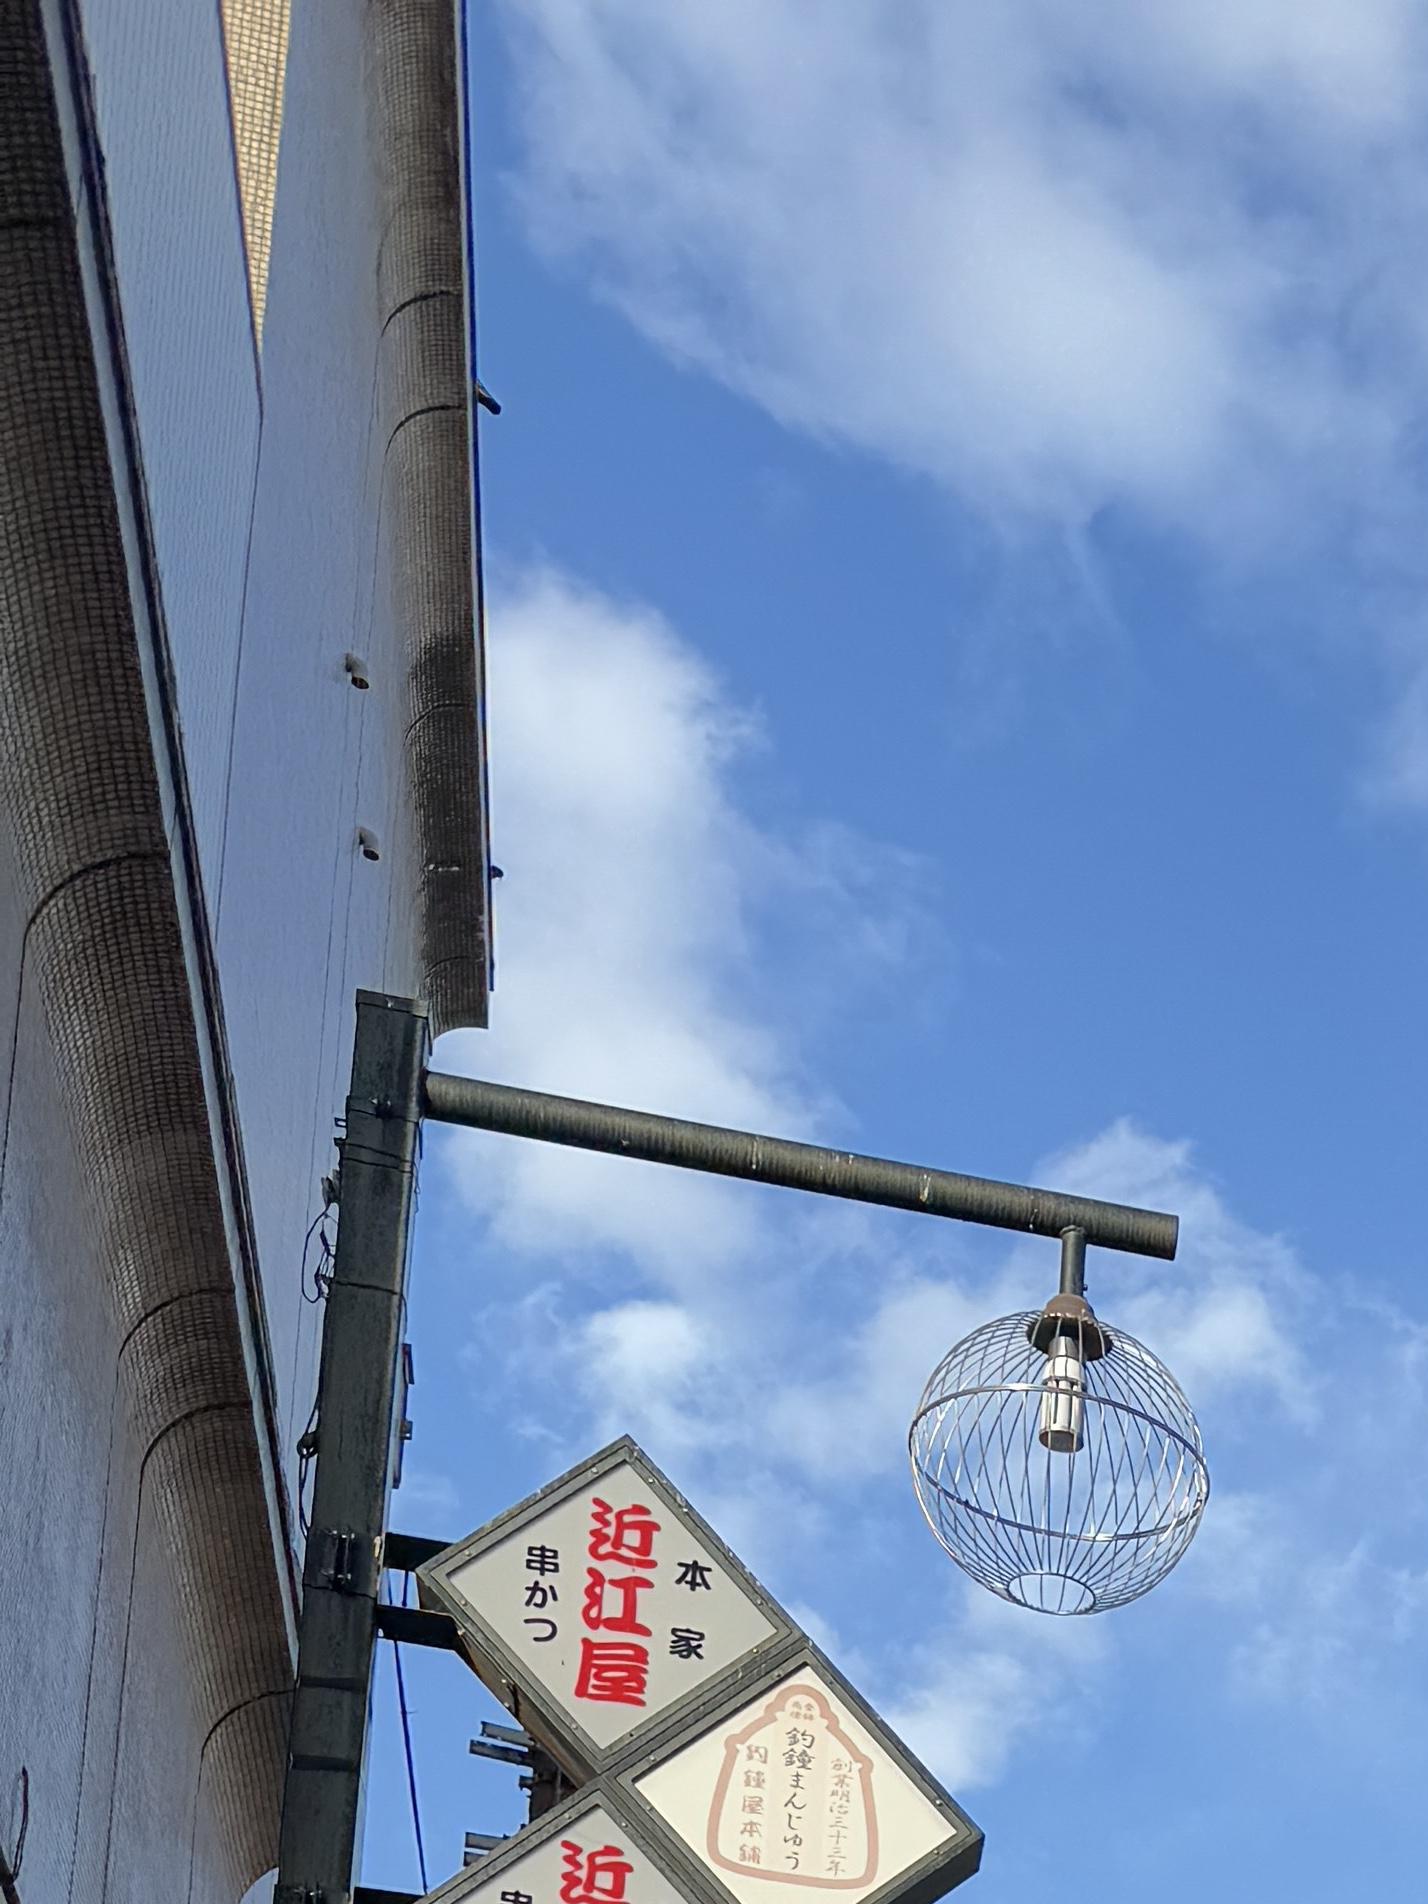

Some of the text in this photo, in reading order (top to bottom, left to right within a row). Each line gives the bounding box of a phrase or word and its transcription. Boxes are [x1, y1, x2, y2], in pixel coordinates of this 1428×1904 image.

[524, 1545, 560, 1643] 串かつ
[575, 1497, 661, 1707] 近江屋
[669, 1559, 713, 1660] 本家
